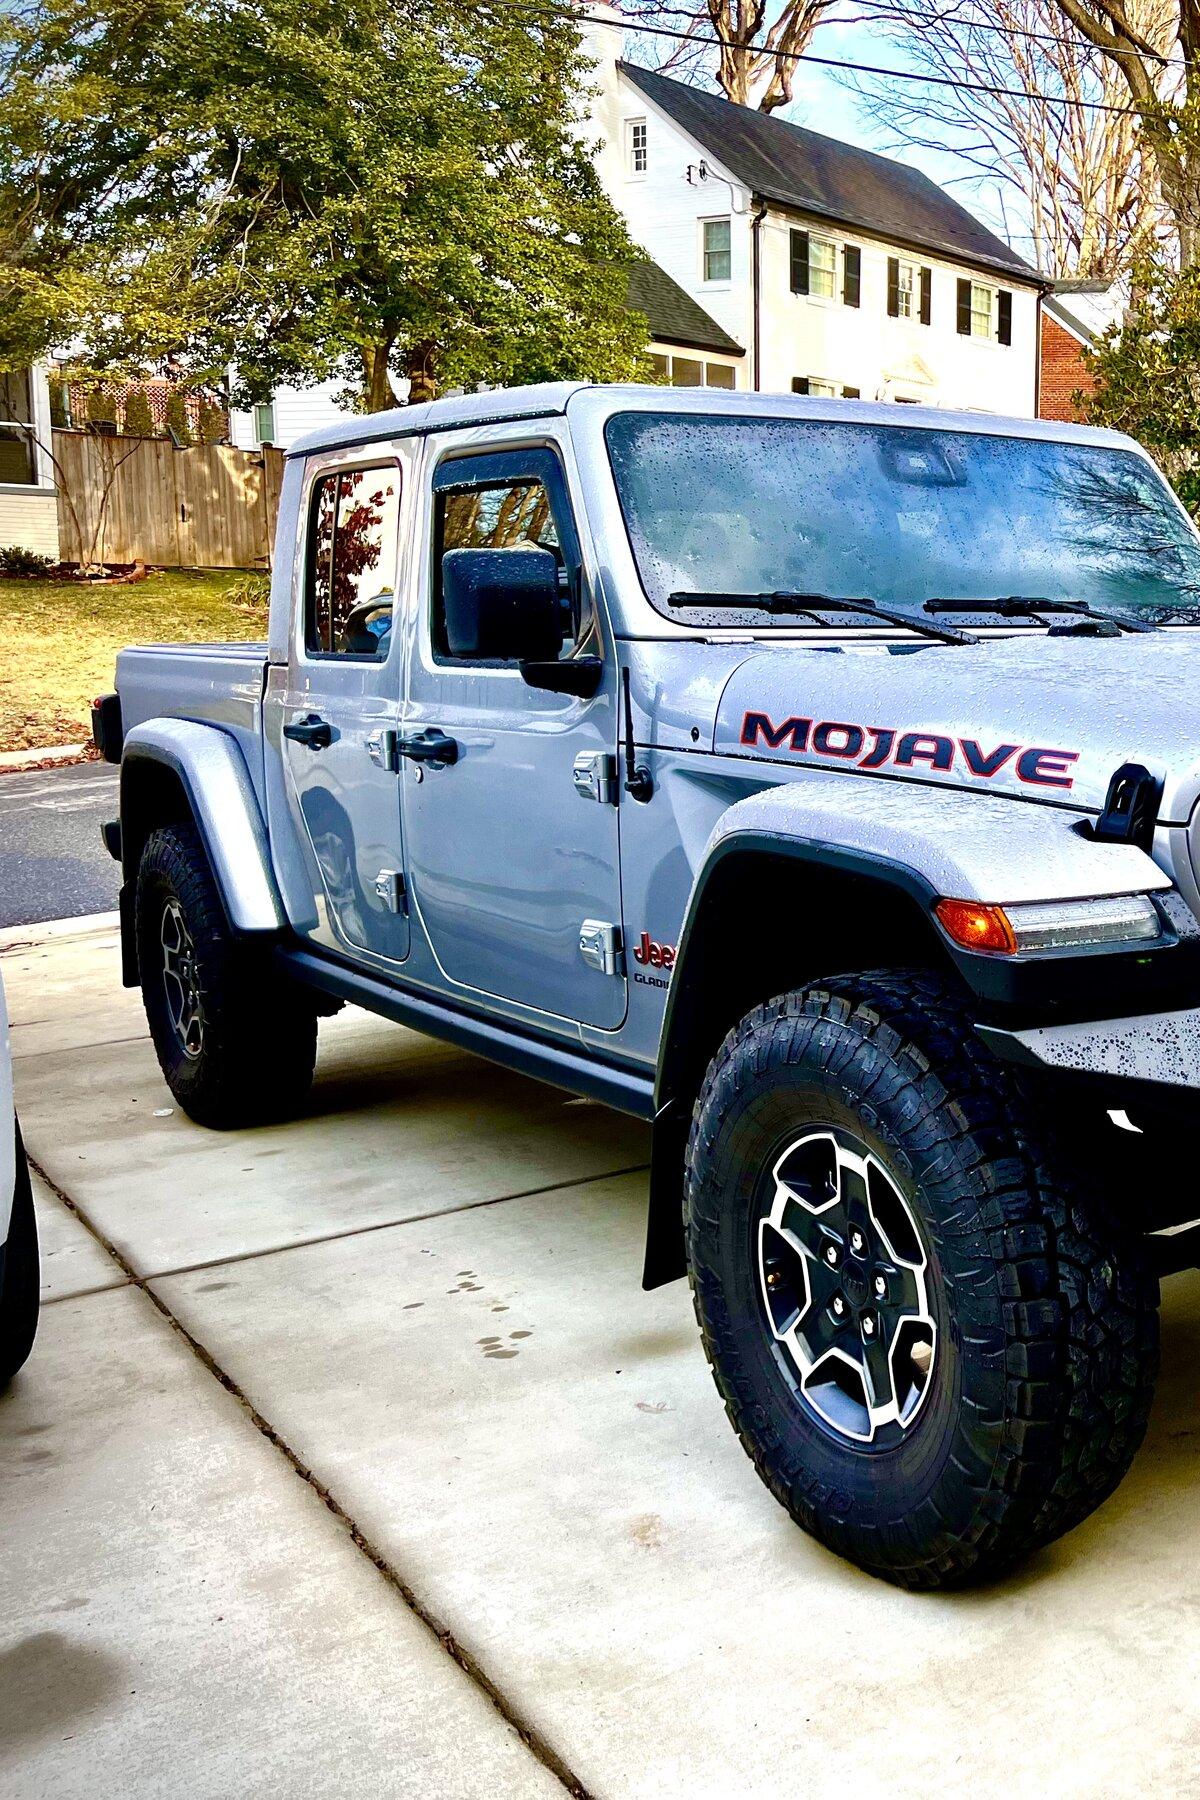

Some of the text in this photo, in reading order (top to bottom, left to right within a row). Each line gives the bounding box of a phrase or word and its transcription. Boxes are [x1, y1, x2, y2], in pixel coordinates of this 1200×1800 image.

[739, 710, 1080, 789] MOJAVE
[633, 931, 676, 971] Jee
[634, 972, 670, 990] GLADI
